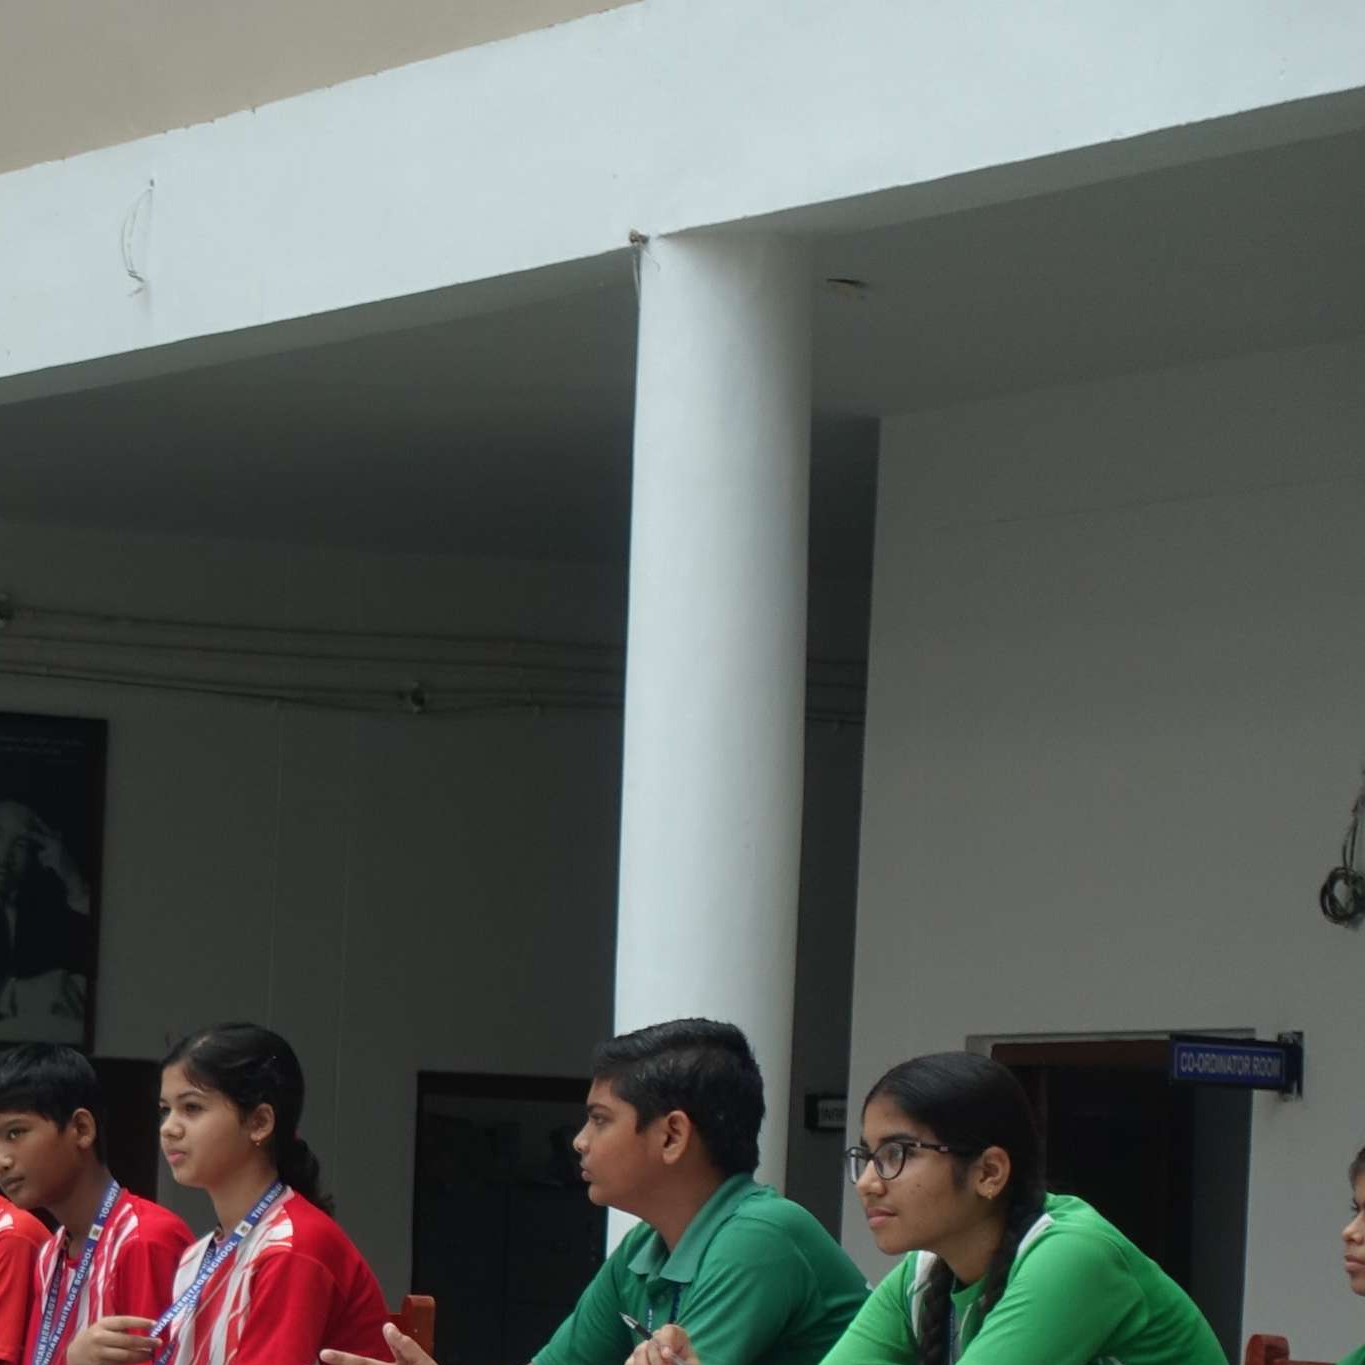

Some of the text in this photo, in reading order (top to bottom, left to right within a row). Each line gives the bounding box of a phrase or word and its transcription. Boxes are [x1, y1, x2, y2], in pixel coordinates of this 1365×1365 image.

[1253, 1056, 1281, 1078] ROOM
[57, 1287, 78, 1335] HERITAGE
[74, 1246, 94, 1284] SCHOOL
[150, 1311, 174, 1338] NDIAN
[171, 1273, 209, 1314] HERITAGE
[207, 1239, 238, 1274] SCHOOL
[252, 1201, 268, 1219] THE
[39, 1296, 57, 1342] HERITAGE
